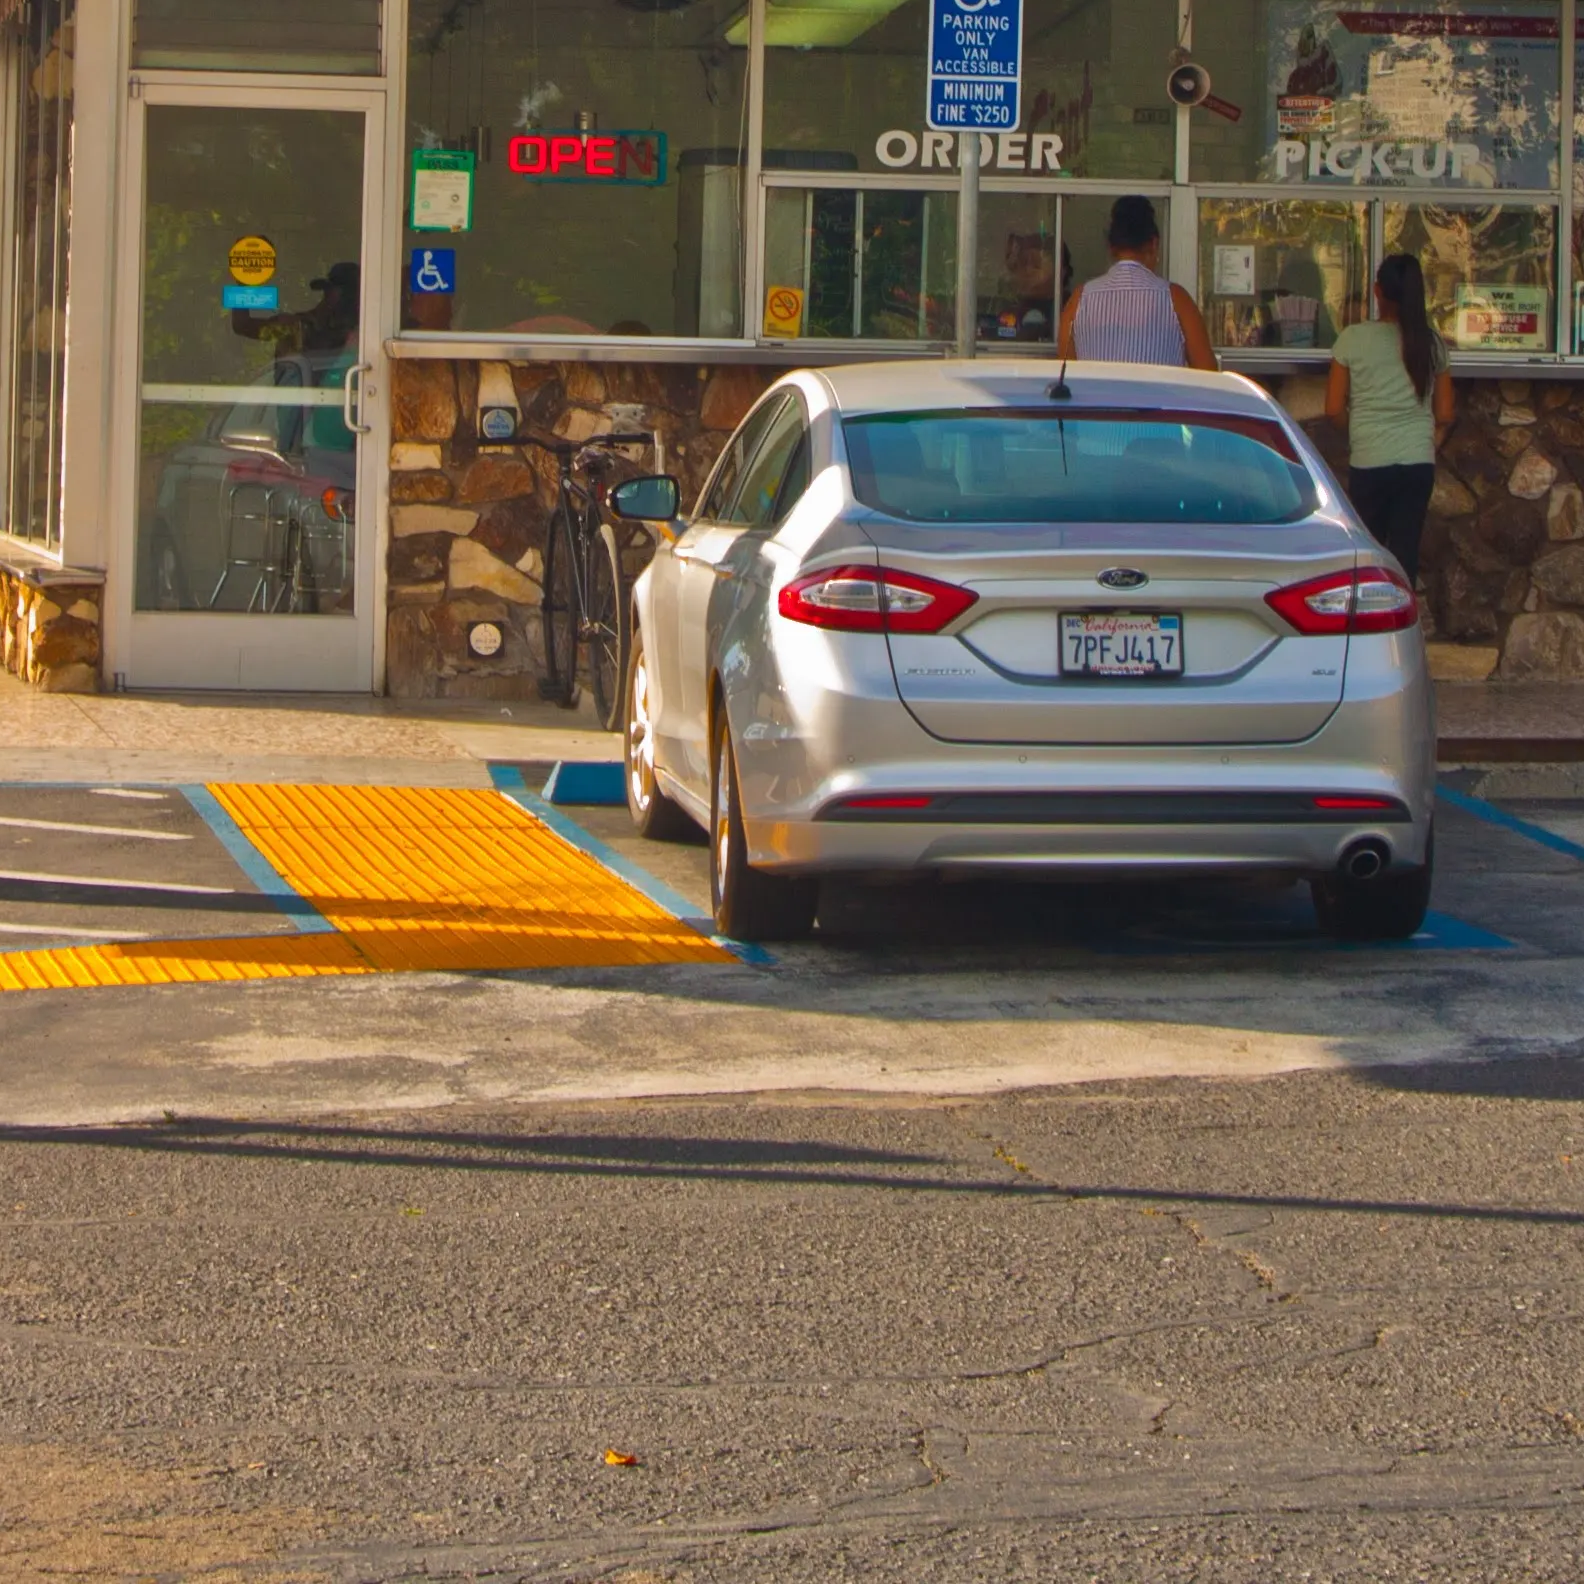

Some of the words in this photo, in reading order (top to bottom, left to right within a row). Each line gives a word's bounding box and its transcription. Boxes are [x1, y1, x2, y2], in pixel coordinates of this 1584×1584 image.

[942, 14, 1009, 31] PARKING
[955, 31, 996, 47] ONLY
[963, 48, 988, 61] VAN
[935, 60, 1015, 75] ACCESSIBLE
[943, 82, 1004, 102] MINIMUM
[937, 104, 967, 122] FINE
[508, 135, 653, 176] OPEN
[1274, 138, 1480, 179] PICK-UP
[231, 257, 275, 267] CAUTION
[1066, 618, 1081, 628] DEC
[1084, 616, 1158, 635] California
[1068, 634, 1175, 665] 7PFJ417
